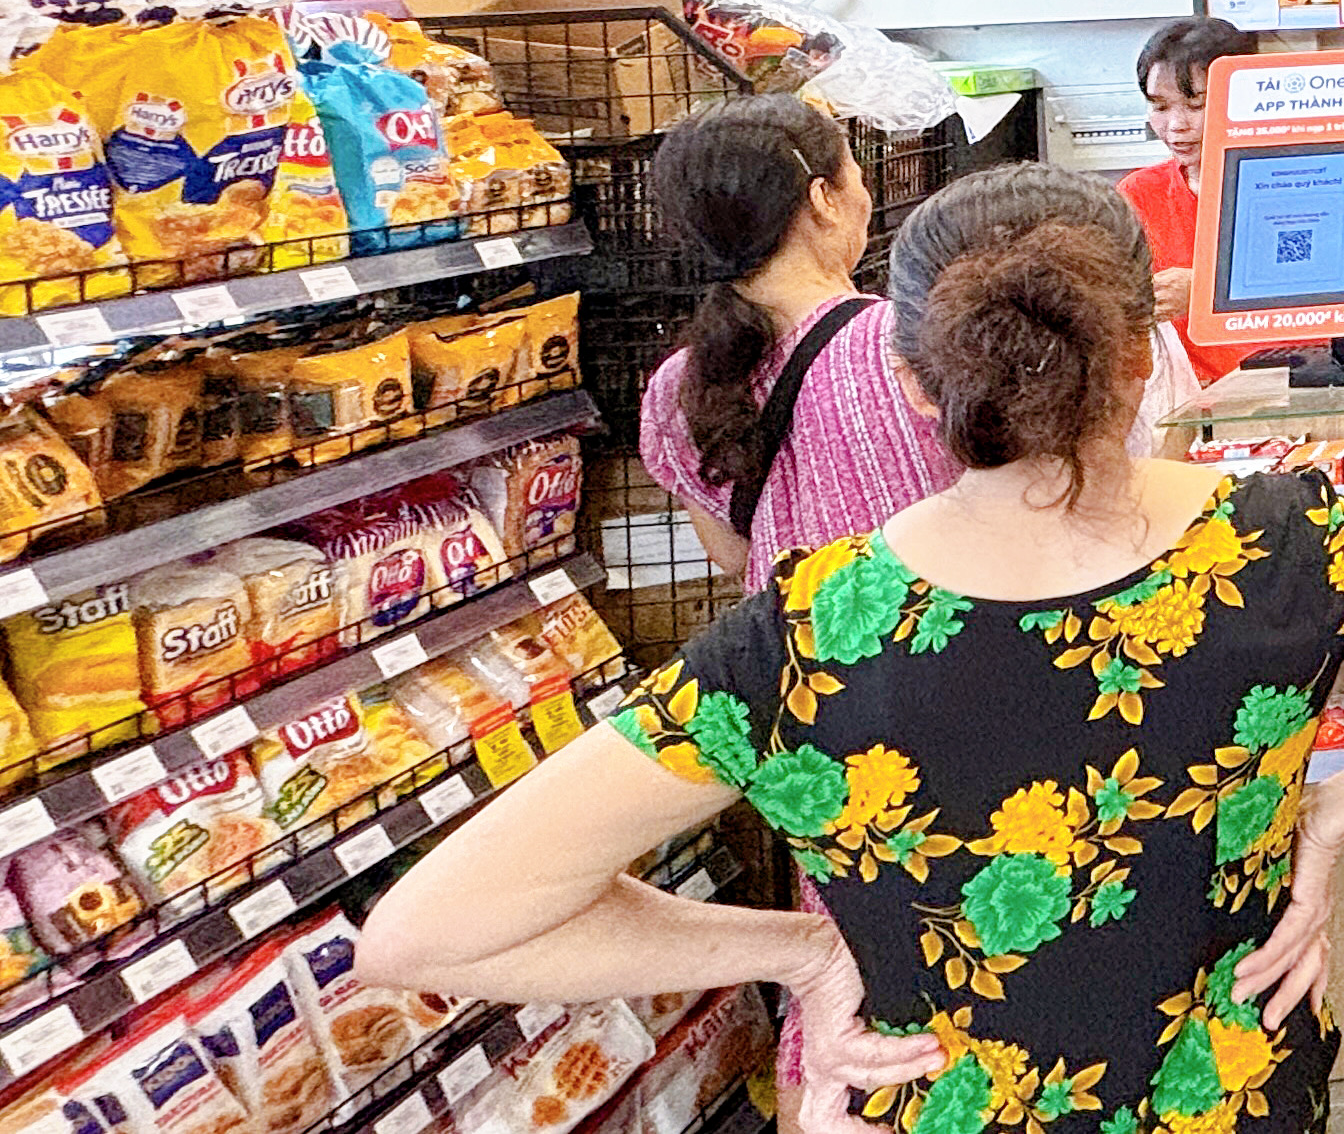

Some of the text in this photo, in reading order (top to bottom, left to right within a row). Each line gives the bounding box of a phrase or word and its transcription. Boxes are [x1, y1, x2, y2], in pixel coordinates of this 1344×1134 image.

[1256, 79, 1280, 92] TẢI
[1253, 100, 1285, 113] APP
[1289, 95, 1343, 110] THÀNH
[1225, 312, 1269, 332] GIẢM
[37, 582, 130, 636] Staff
[162, 602, 240, 662] Staff
[286, 698, 353, 748] Otto
